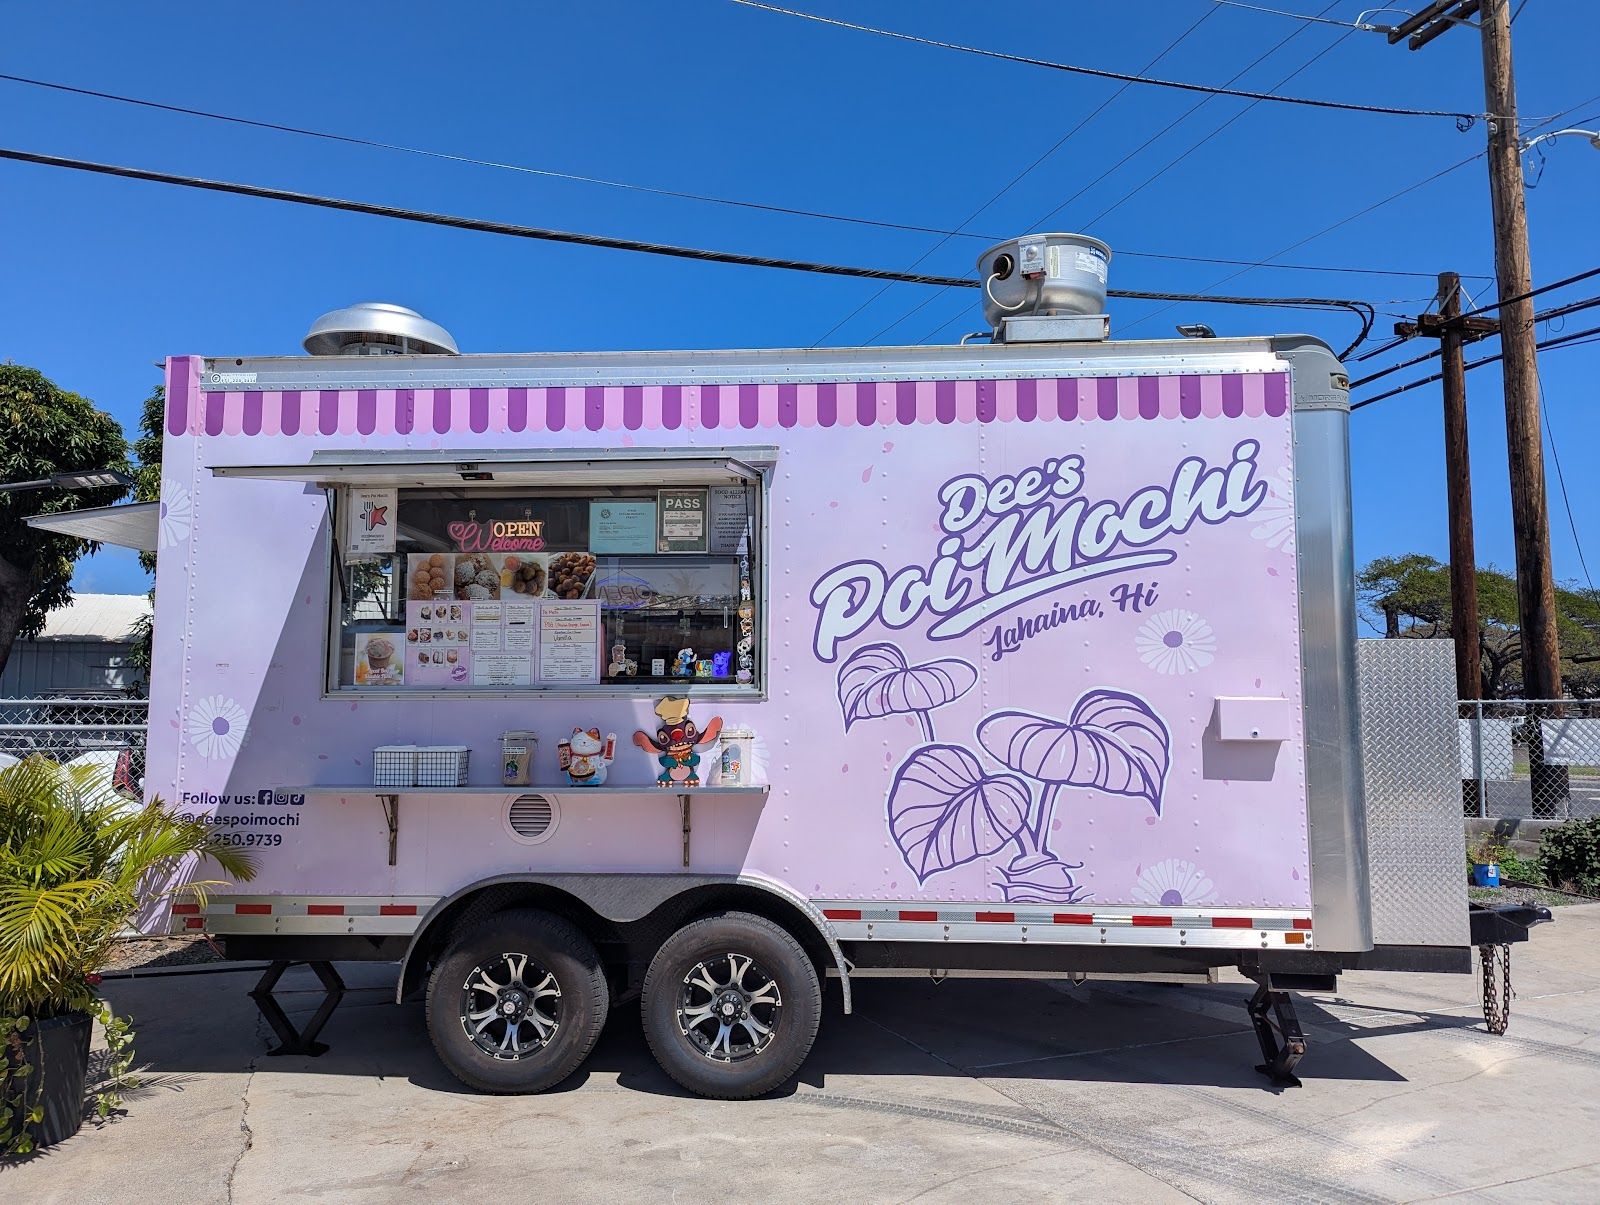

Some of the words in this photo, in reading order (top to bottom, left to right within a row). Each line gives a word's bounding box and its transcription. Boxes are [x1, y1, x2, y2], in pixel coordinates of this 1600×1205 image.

[665, 498, 701, 509] PASS
[938, 454, 1085, 534] Dee's
[449, 520, 546, 552] Welcome
[493, 521, 543, 538] OPEN
[983, 599, 1104, 661] Lahaina,
[1109, 581, 1159, 613] Hi
[182, 792, 231, 805] Follow
[234, 795, 256, 805] us:
